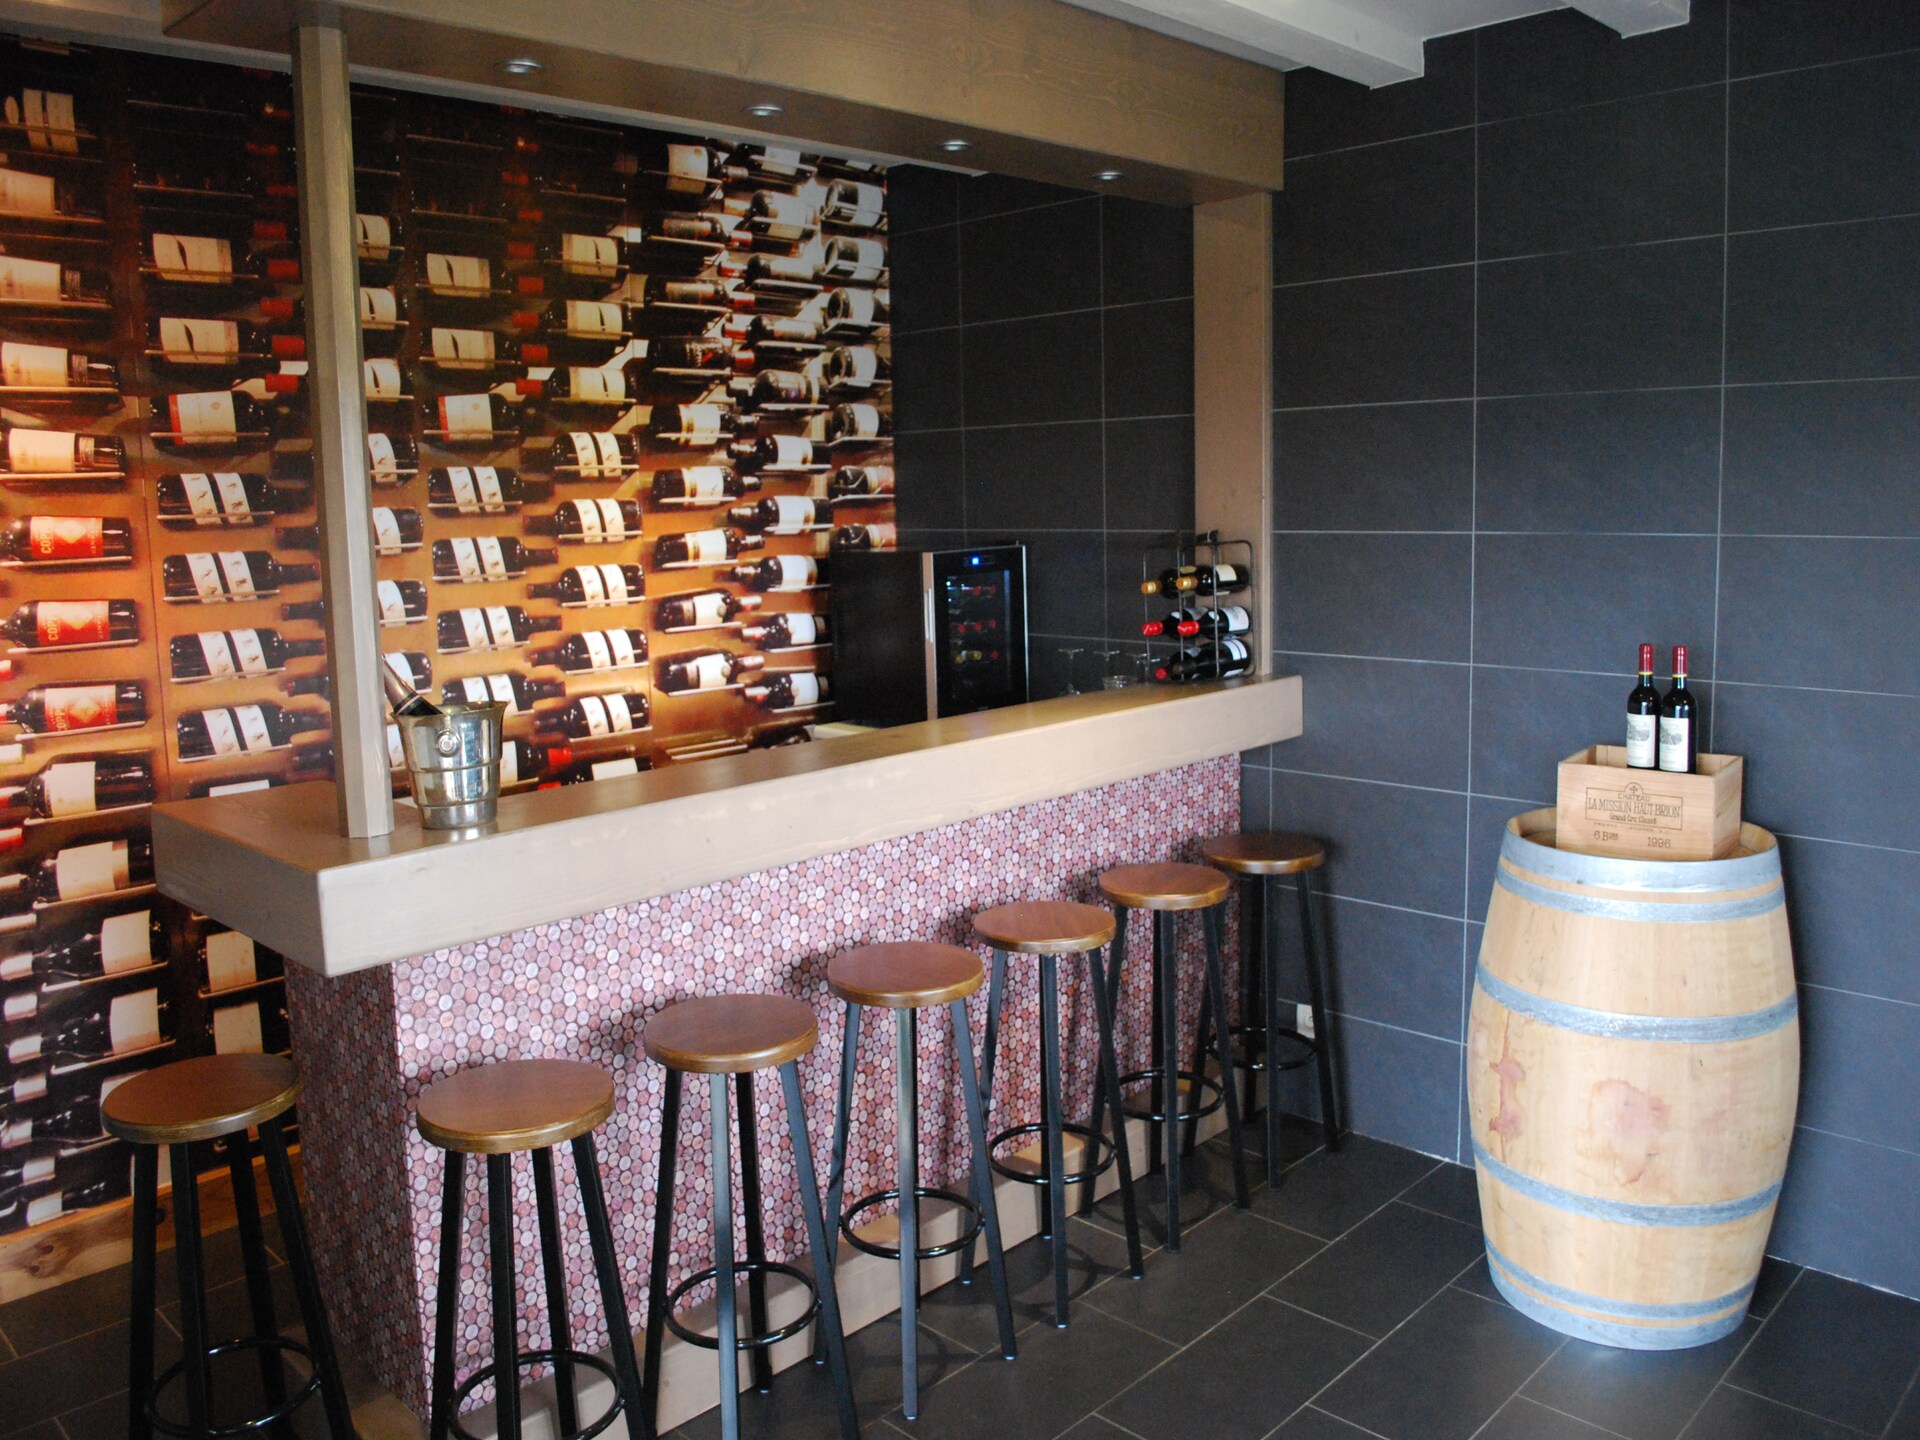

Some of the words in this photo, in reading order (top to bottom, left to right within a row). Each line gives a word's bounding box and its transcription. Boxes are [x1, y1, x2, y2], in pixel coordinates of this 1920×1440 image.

[1588, 797, 1597, 810] LA
[1598, 798, 1632, 813] MISSION
[1609, 813, 1626, 822] Grand
[1627, 814, 1637, 823] Cru
[1594, 830, 1600, 840] 6
[1647, 836, 1671, 848] 1996
